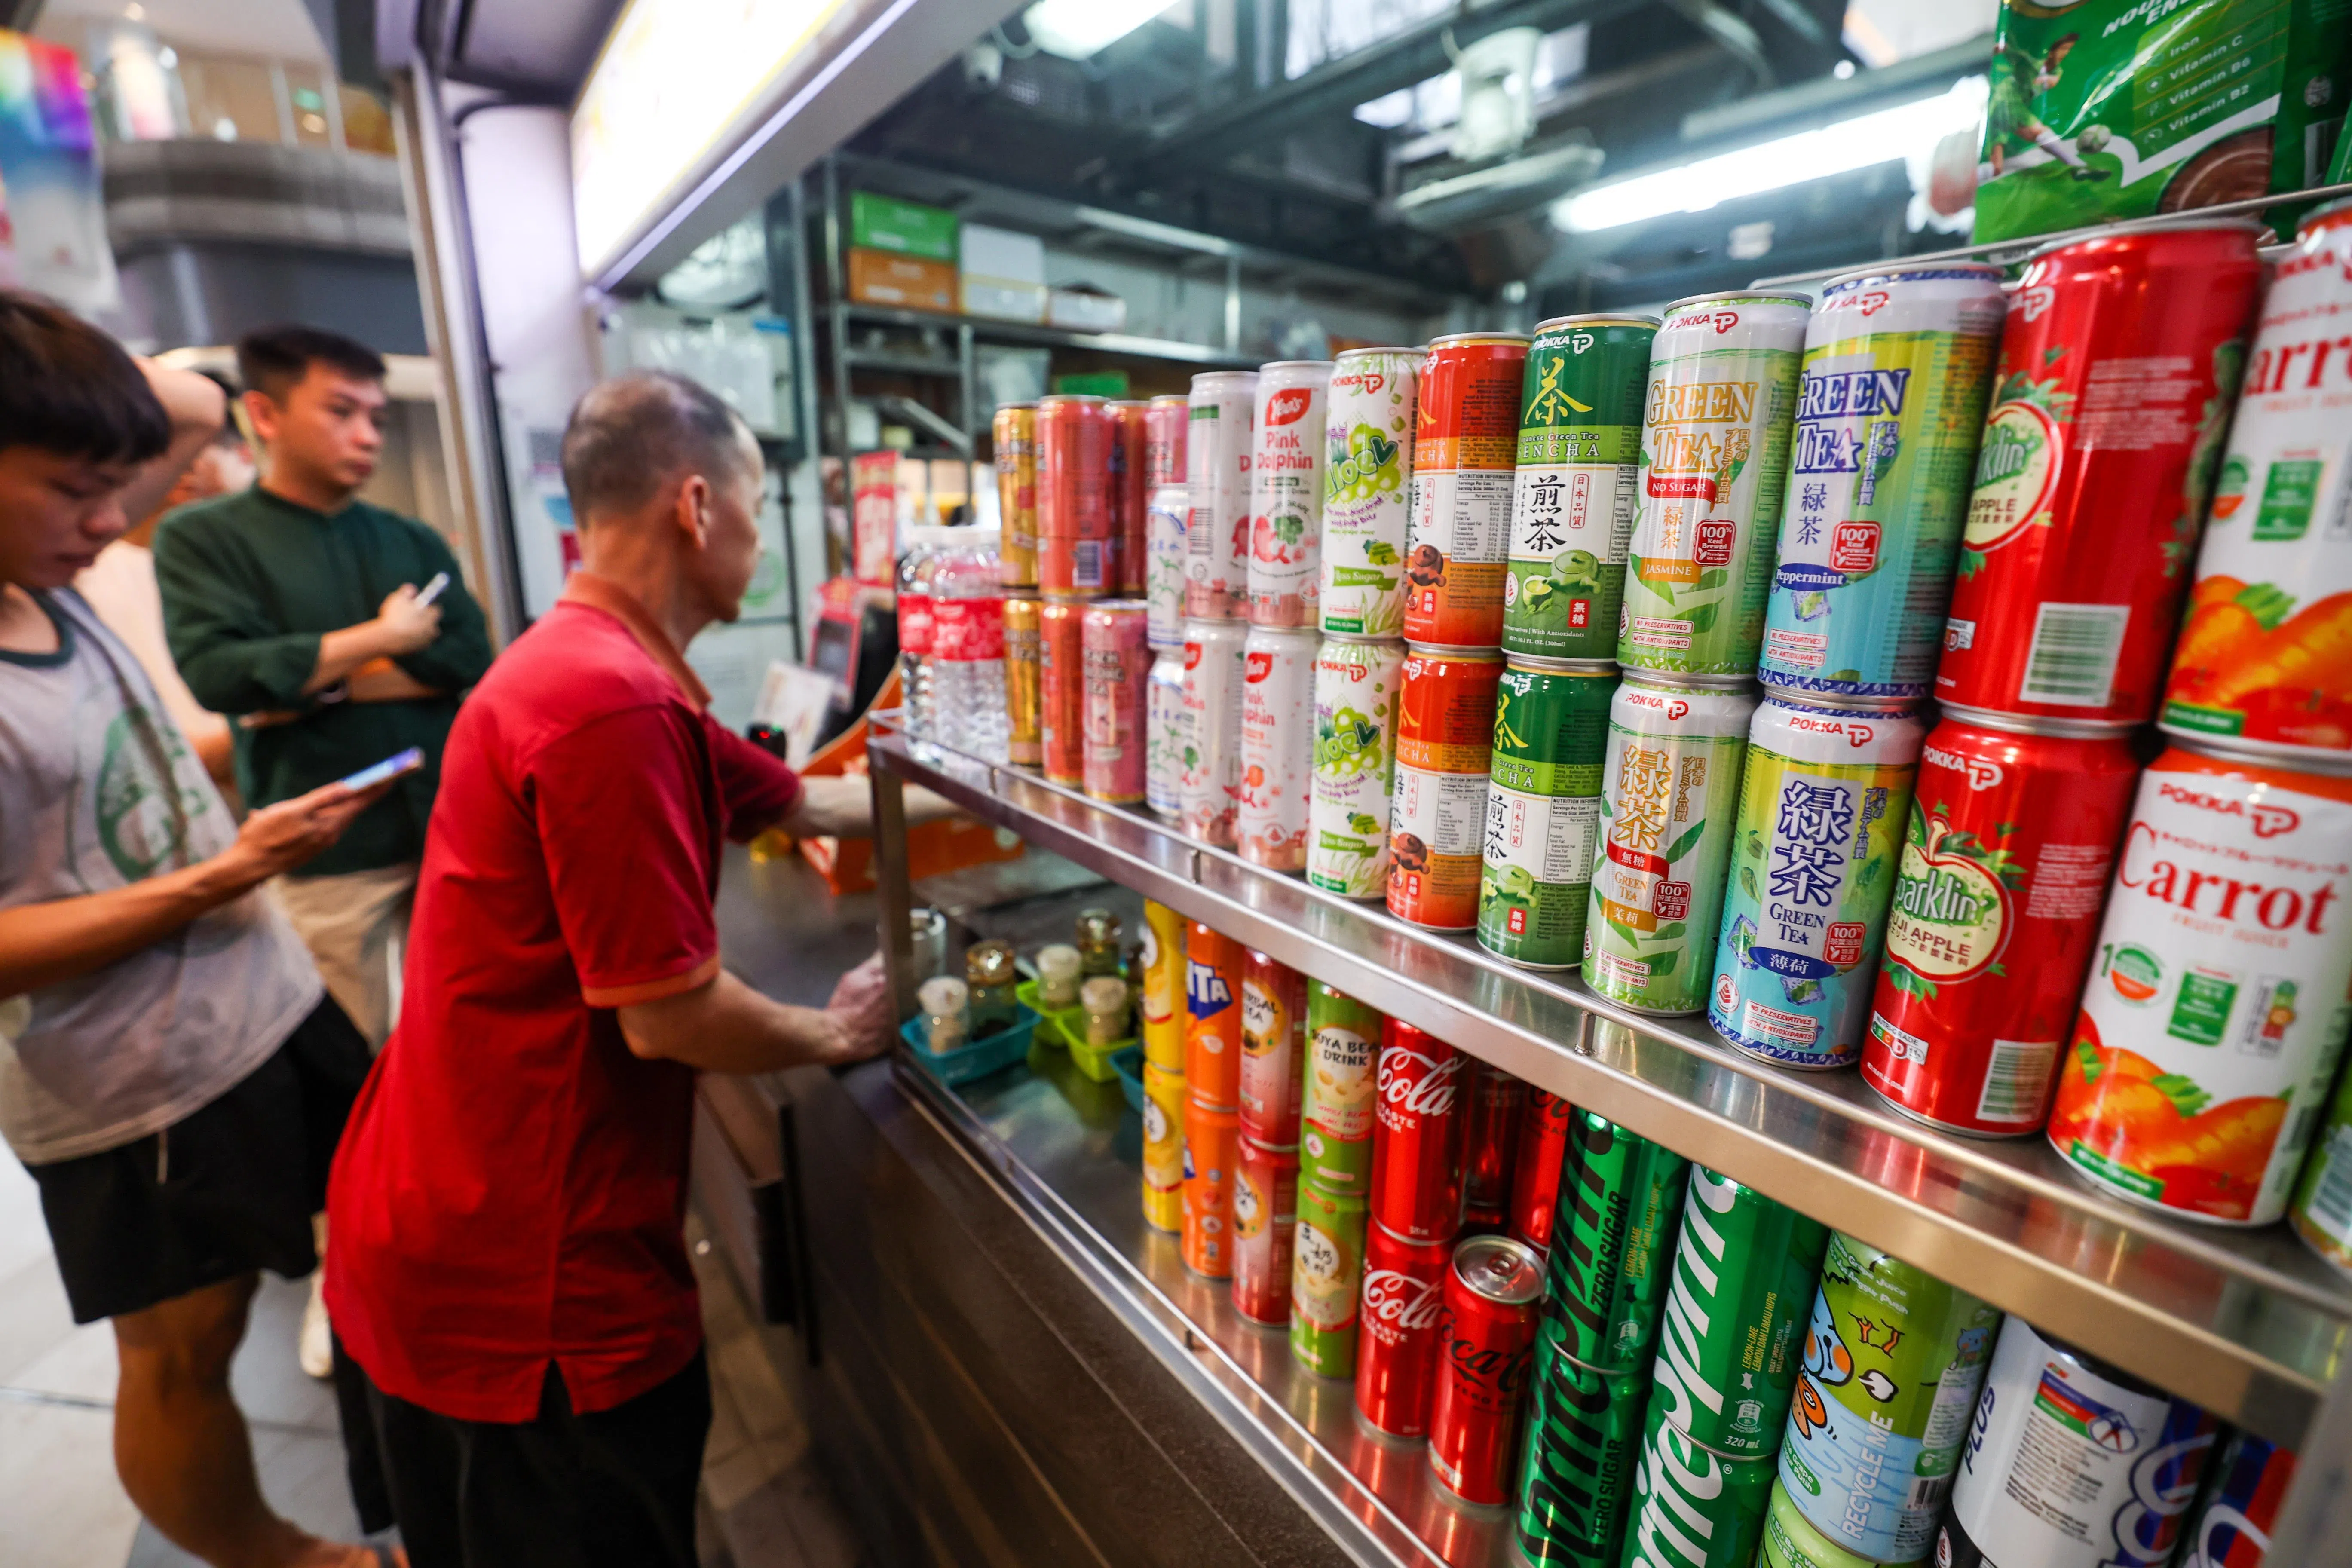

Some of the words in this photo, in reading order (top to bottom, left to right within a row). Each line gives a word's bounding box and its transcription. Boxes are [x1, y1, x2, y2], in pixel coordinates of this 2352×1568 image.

[2170, 36, 2199, 56] Iron
[2170, 45, 2227, 80] Vitamin
[2231, 35, 2242, 46] C
[2169, 71, 2226, 104] Vitamin
[2169, 98, 2226, 130] Vitamin
[1524, 356, 1594, 425] 茶
[1646, 379, 1759, 428] GREEN
[1266, 429, 1300, 448] Pink
[1548, 432, 1577, 441] Green
[1581, 432, 1600, 440] Tea
[1794, 422, 1865, 474] TEA
[1257, 451, 1314, 471] Dolphin
[1653, 427, 1721, 474] TEA
[1652, 482, 1666, 492] NO
[1668, 482, 1707, 492] SUGAR
[1524, 475, 1567, 552] 煎茶
[1572, 476, 1586, 527] 日本品質
[1795, 482, 1828, 545] 緑茶
[1660, 505, 1683, 549] 緑茶
[1702, 526, 1732, 538] 100%
[1645, 564, 1692, 576] JASMINE
[1776, 568, 1845, 586] Peppermint
[1645, 621, 1688, 631] PRESERVATIVES
[1778, 633, 1822, 645] PRESERVATIVES
[1647, 637, 1689, 646] ANTIOXIDANTS
[1779, 651, 1822, 662] ANTIOXIDANTS
[1625, 693, 1663, 708] POKKA
[1788, 717, 1844, 735] POKKA
[1498, 758, 1517, 770] Green
[1519, 764, 1534, 774] Tea
[1922, 744, 1966, 772] POKKA
[1692, 757, 1706, 787] 日本の
[1615, 744, 1672, 851] 緑茶
[1873, 787, 1888, 819] 日本の
[2159, 782, 2244, 817] POKKA
[1485, 793, 1508, 859] 煎茶
[1512, 802, 1522, 845] 日本品質
[1770, 780, 1854, 907] 緑茶
[1621, 851, 1645, 868] 無糖
[1614, 871, 1648, 891] GREEN
[2118, 819, 2339, 936] Carrot
[1620, 886, 1637, 902] TEA
[1895, 867, 1989, 921] parklin'
[1613, 907, 1639, 925] 茉莉
[1770, 903, 1826, 928] GREEN
[1778, 923, 1810, 946] TEA
[1911, 927, 1972, 957] APPLE
[1770, 953, 1809, 975] 薄荷
[1761, 1008, 1813, 1026] PRESERVATIVES
[1763, 1023, 1813, 1040] ANTIOXIDANTS
[1323, 1049, 1369, 1066] DRINK
[1894, 1043, 1905, 1054] D
[1600, 1190, 1631, 1262] SUGAR
[1591, 1263, 1615, 1314] ZERO
[1848, 1255, 1874, 1280] Grape
[1876, 1278, 1907, 1297] Juice
[1765, 1291, 1777, 1312] NIPIS
[1760, 1310, 1773, 1333] LIMAU
[1741, 1325, 1759, 1369] LEMON-LIME
[1756, 1331, 1769, 1349] DAN
[1751, 1346, 1765, 1372] LEMON
[1724, 1435, 1746, 1448] 320
[1963, 1380, 1997, 1476] PLUS
[1599, 1439, 1624, 1496] SUGAR
[1792, 1453, 1814, 1483] Grape
[1794, 1466, 1813, 1493] Putih
[1841, 1447, 1884, 1540] RECYCLE
[1865, 1410, 1894, 1449] ME
[1592, 1492, 1615, 1540] ZERO
